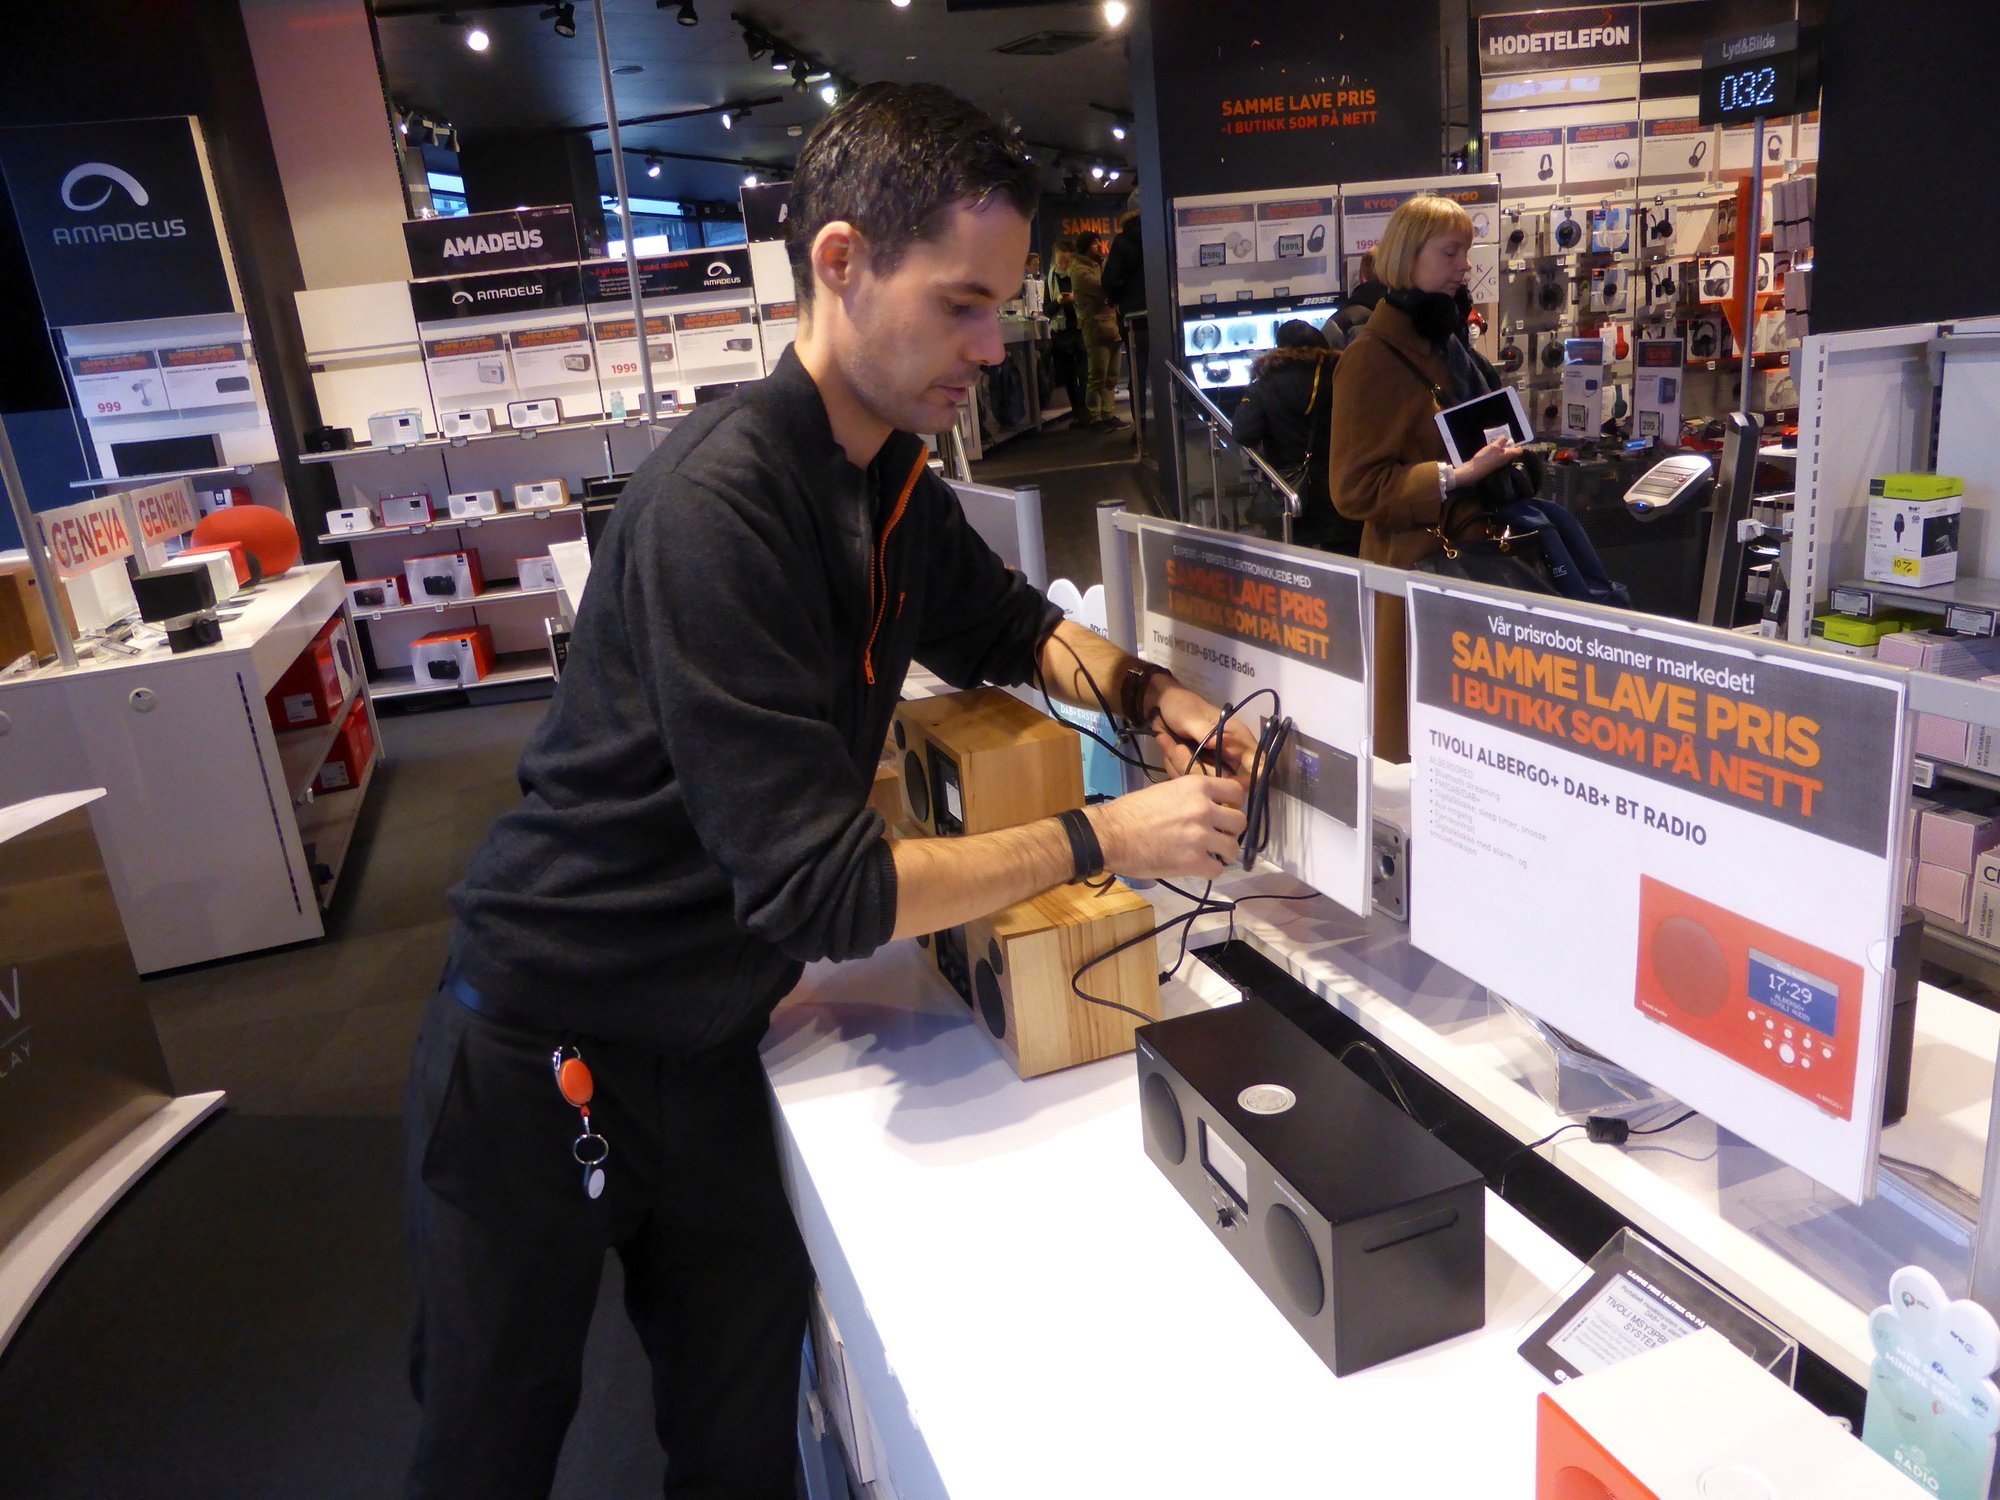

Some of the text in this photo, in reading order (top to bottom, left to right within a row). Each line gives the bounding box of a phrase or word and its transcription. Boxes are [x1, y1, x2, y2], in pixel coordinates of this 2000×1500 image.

[1489, 25, 1630, 56] HODETELEFON
[1722, 32, 1776, 60] Lyd&Bilde
[1222, 89, 1376, 117] SAMME LAVE PRIS
[1719, 66, 1776, 112] 032
[1235, 116, 1286, 134] BUTIKK
[1289, 115, 1318, 130] SOM
[1321, 111, 1339, 127] PÅ
[1342, 110, 1377, 126] NETT
[53, 218, 187, 246] AMADEUS
[1061, 217, 1111, 235] SAMME
[442, 229, 544, 259] AMADEUS
[477, 284, 544, 301] AMADEUS
[703, 276, 742, 287] AMADEUS
[1297, 295, 1339, 307] BOSE
[611, 362, 638, 375] 1999
[97, 401, 122, 414] 999
[138, 488, 191, 538] GENEVA
[51, 507, 129, 569] GENEVA
[1166, 559, 1329, 630] SAMME LAVE PRIS
[1292, 573, 1312, 589] MED
[1224, 605, 1258, 639] SOM
[1260, 612, 1282, 646] PÅ
[1283, 623, 1330, 661] NETT
[1152, 629, 1174, 647] Tivoli
[1231, 656, 1256, 678] Radio
[1487, 614, 1756, 696] Vår prisrobot skanner markedet!
[1452, 630, 1821, 767] SAMME LAVE PRIS
[1451, 673, 1824, 818] I BUTIKK SOM PÅ NETT
[1429, 729, 1708, 848] TIVOLI ALBERGO+ DAB+ BT RADIO
[1768, 973, 1813, 1004] 17:29
